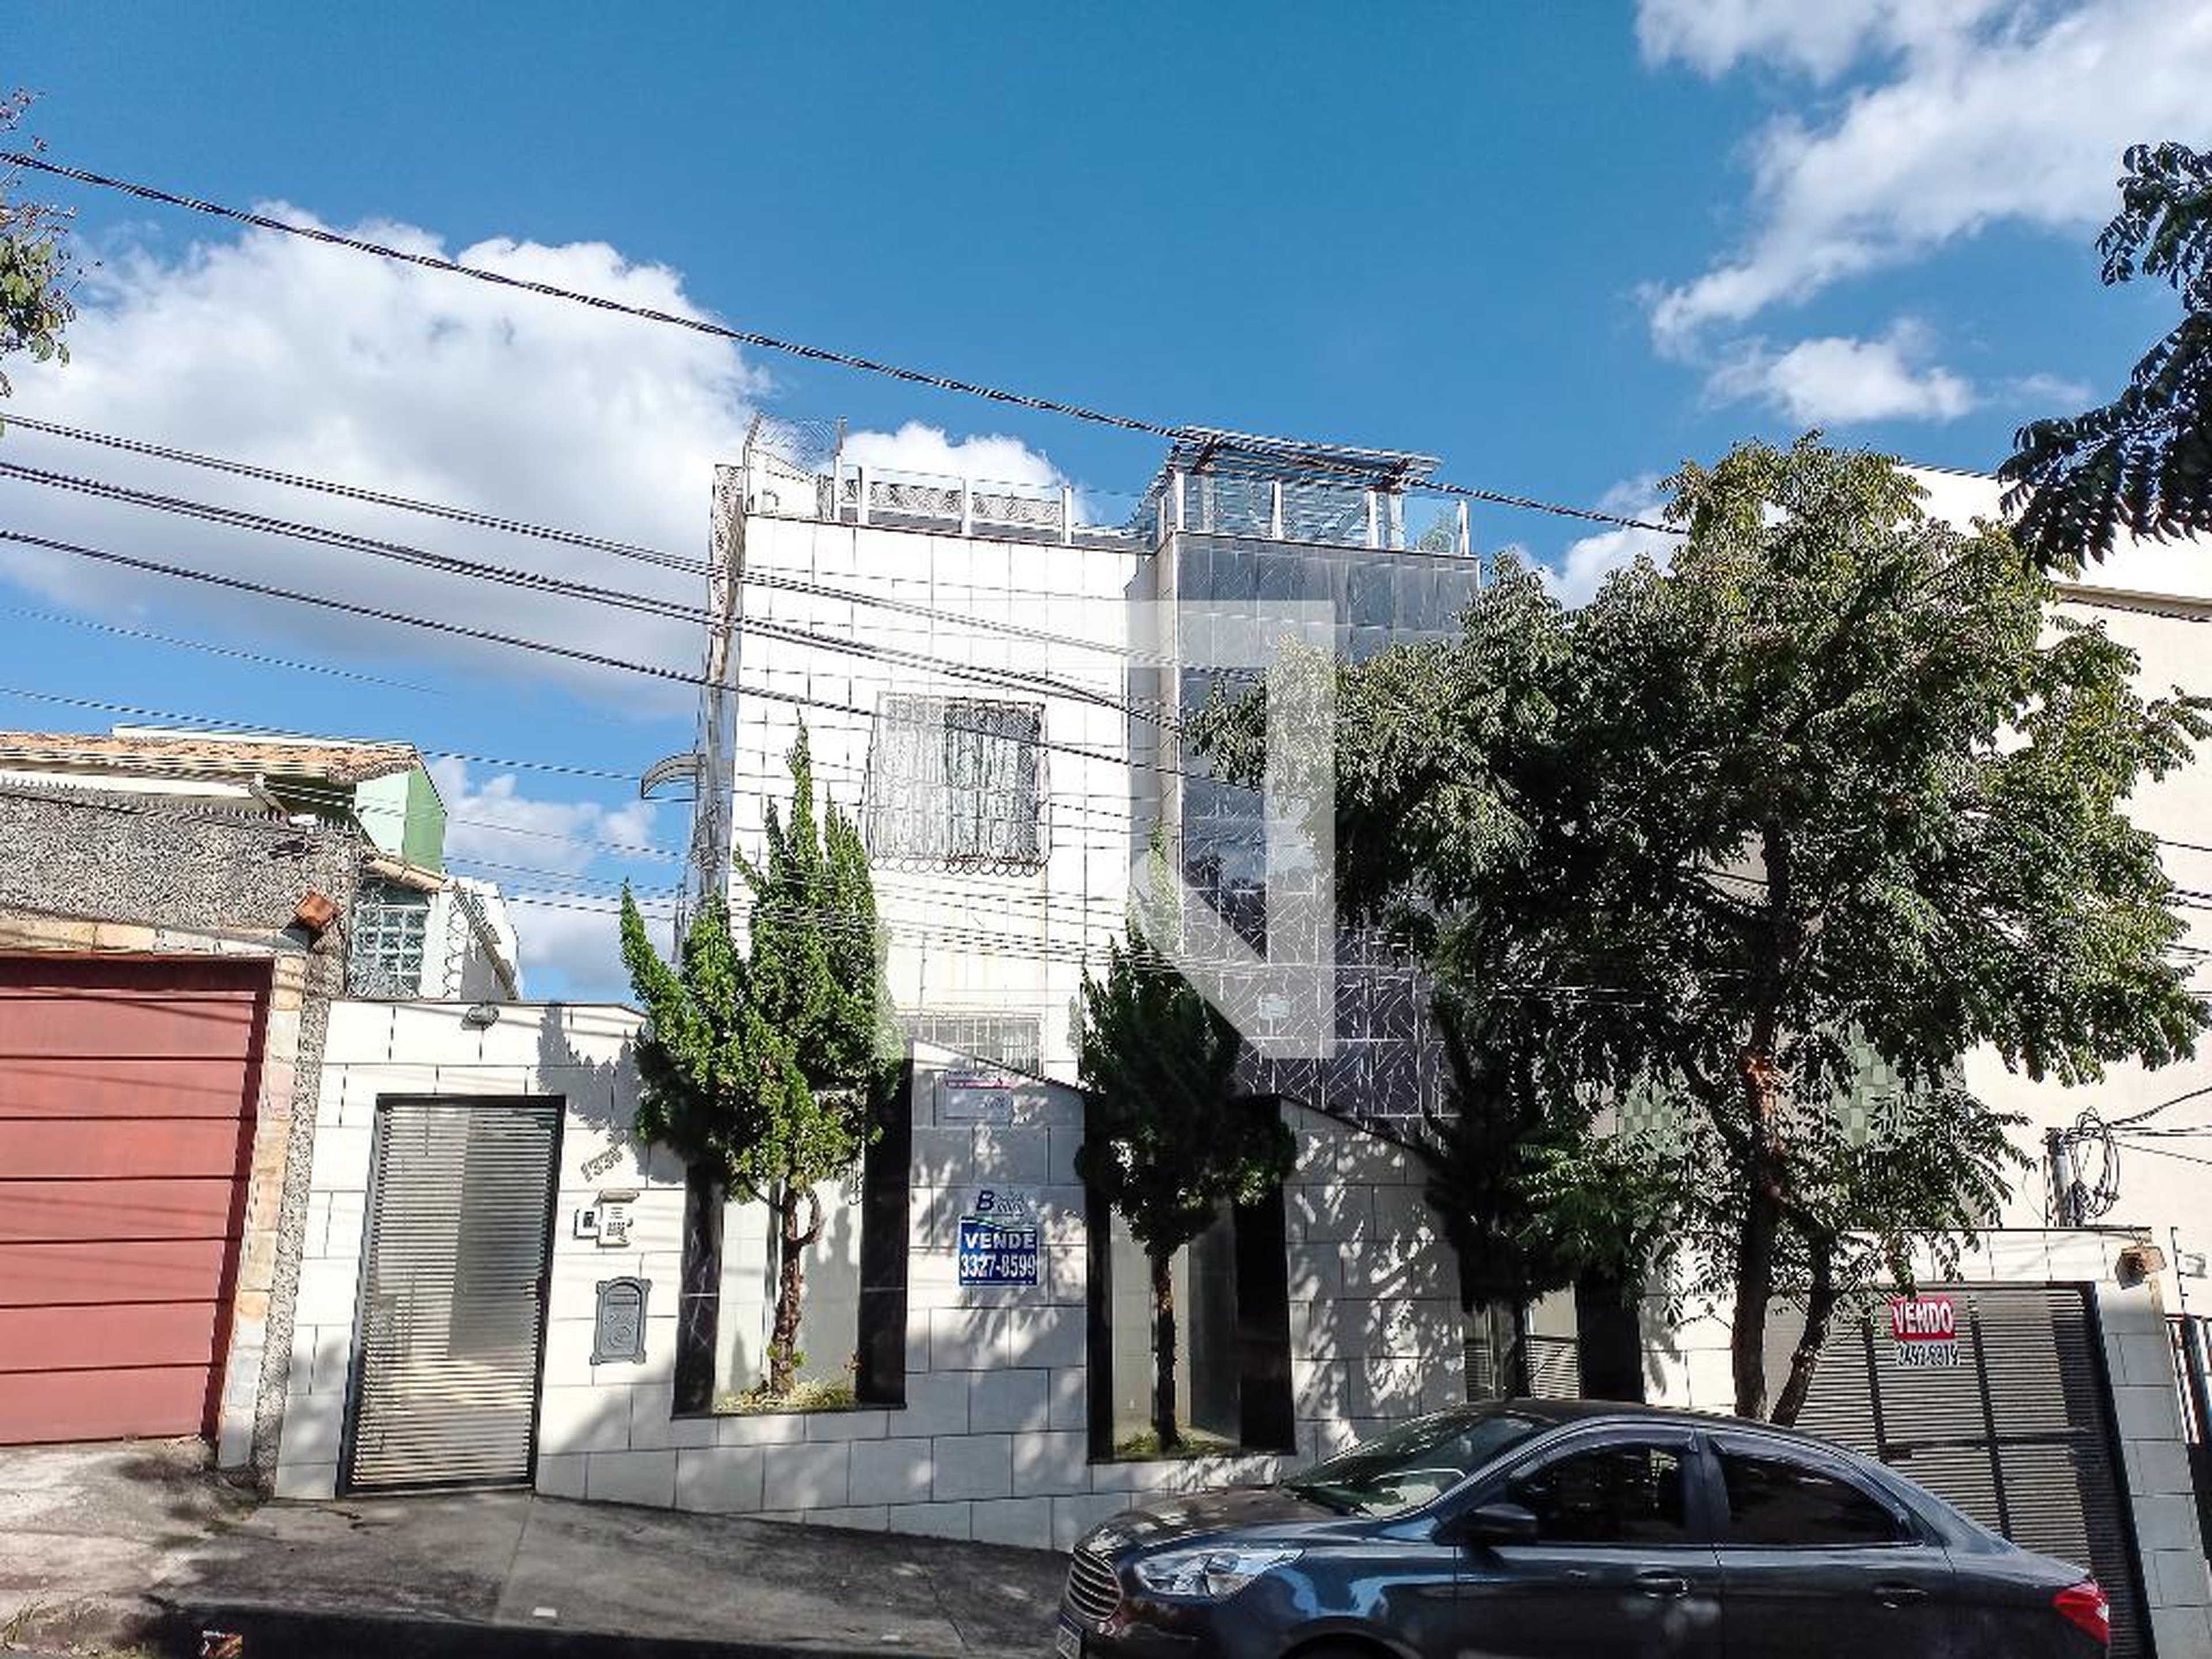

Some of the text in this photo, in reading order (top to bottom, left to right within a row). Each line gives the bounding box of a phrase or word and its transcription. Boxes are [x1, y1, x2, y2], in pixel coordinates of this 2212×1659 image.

[965, 1233, 1035, 1249] VENDE
[960, 1253, 1036, 1277] 3327-8599
[1892, 1301, 1953, 1334] VENDO
